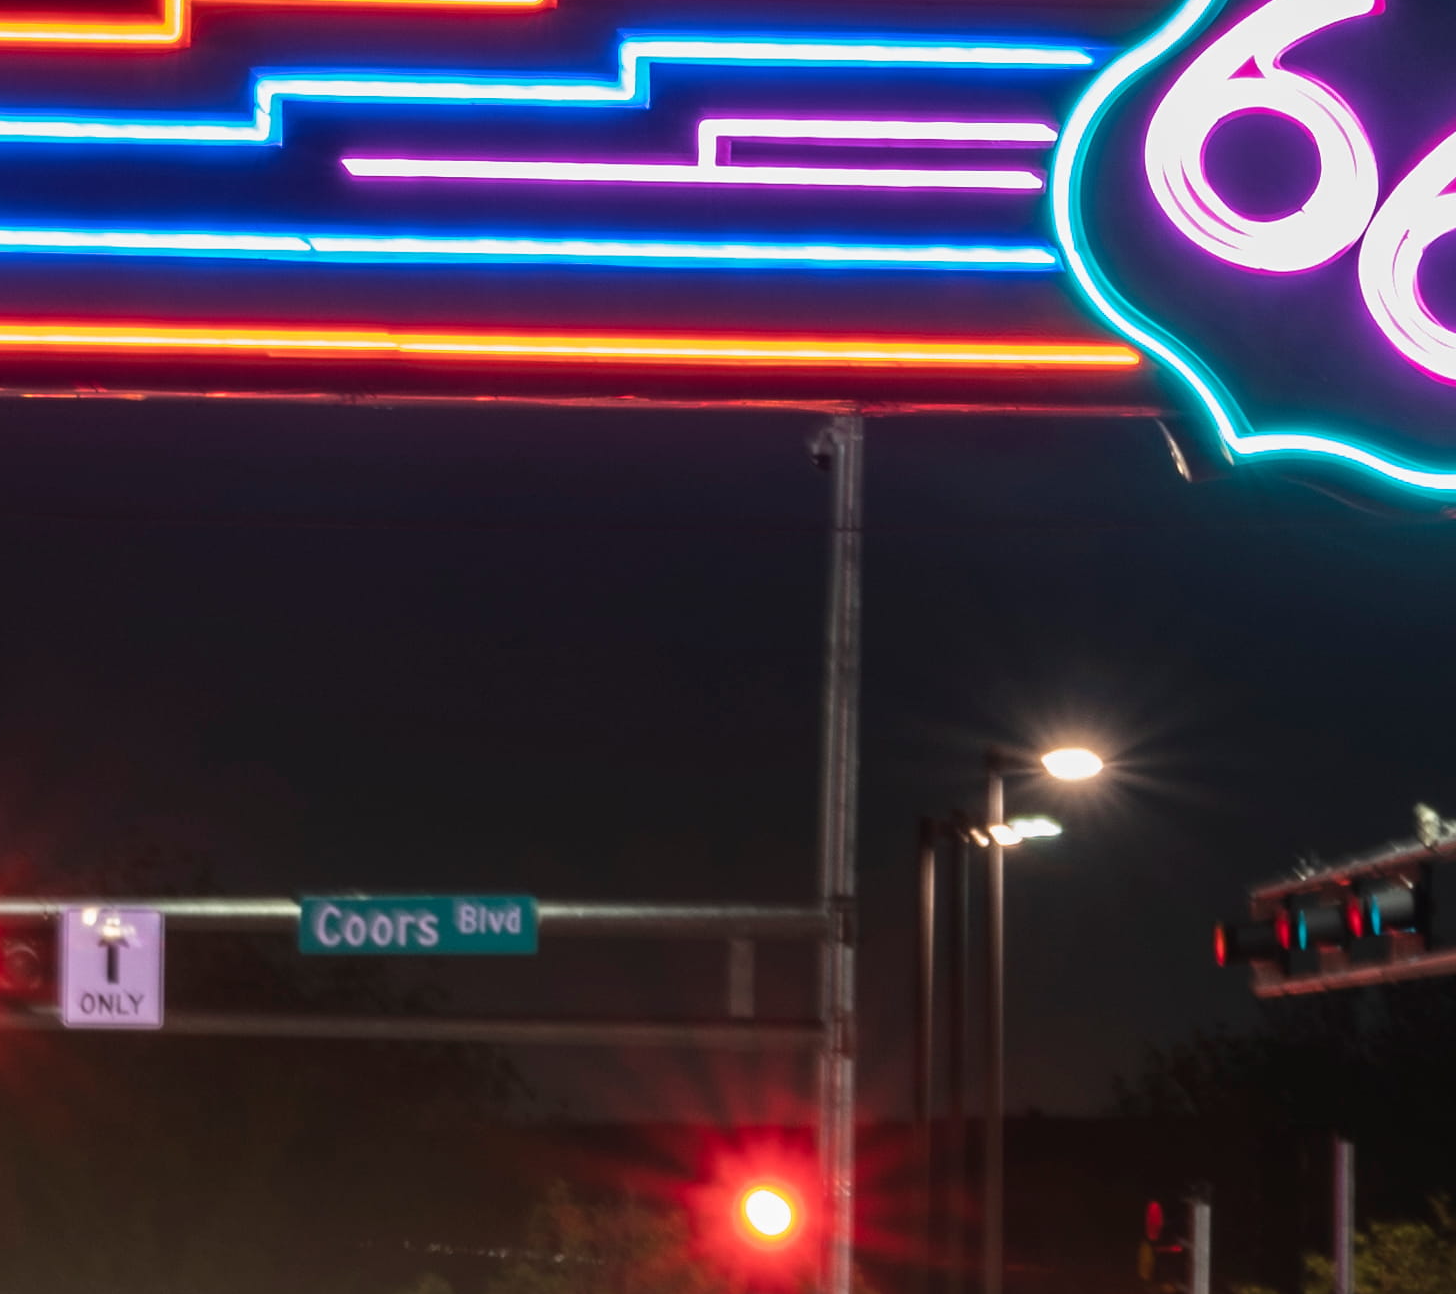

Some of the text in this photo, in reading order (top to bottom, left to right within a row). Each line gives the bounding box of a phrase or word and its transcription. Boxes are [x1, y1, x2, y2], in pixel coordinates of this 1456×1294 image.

[314, 900, 523, 947] Coors Blvd
[80, 992, 144, 1016] ONLY
